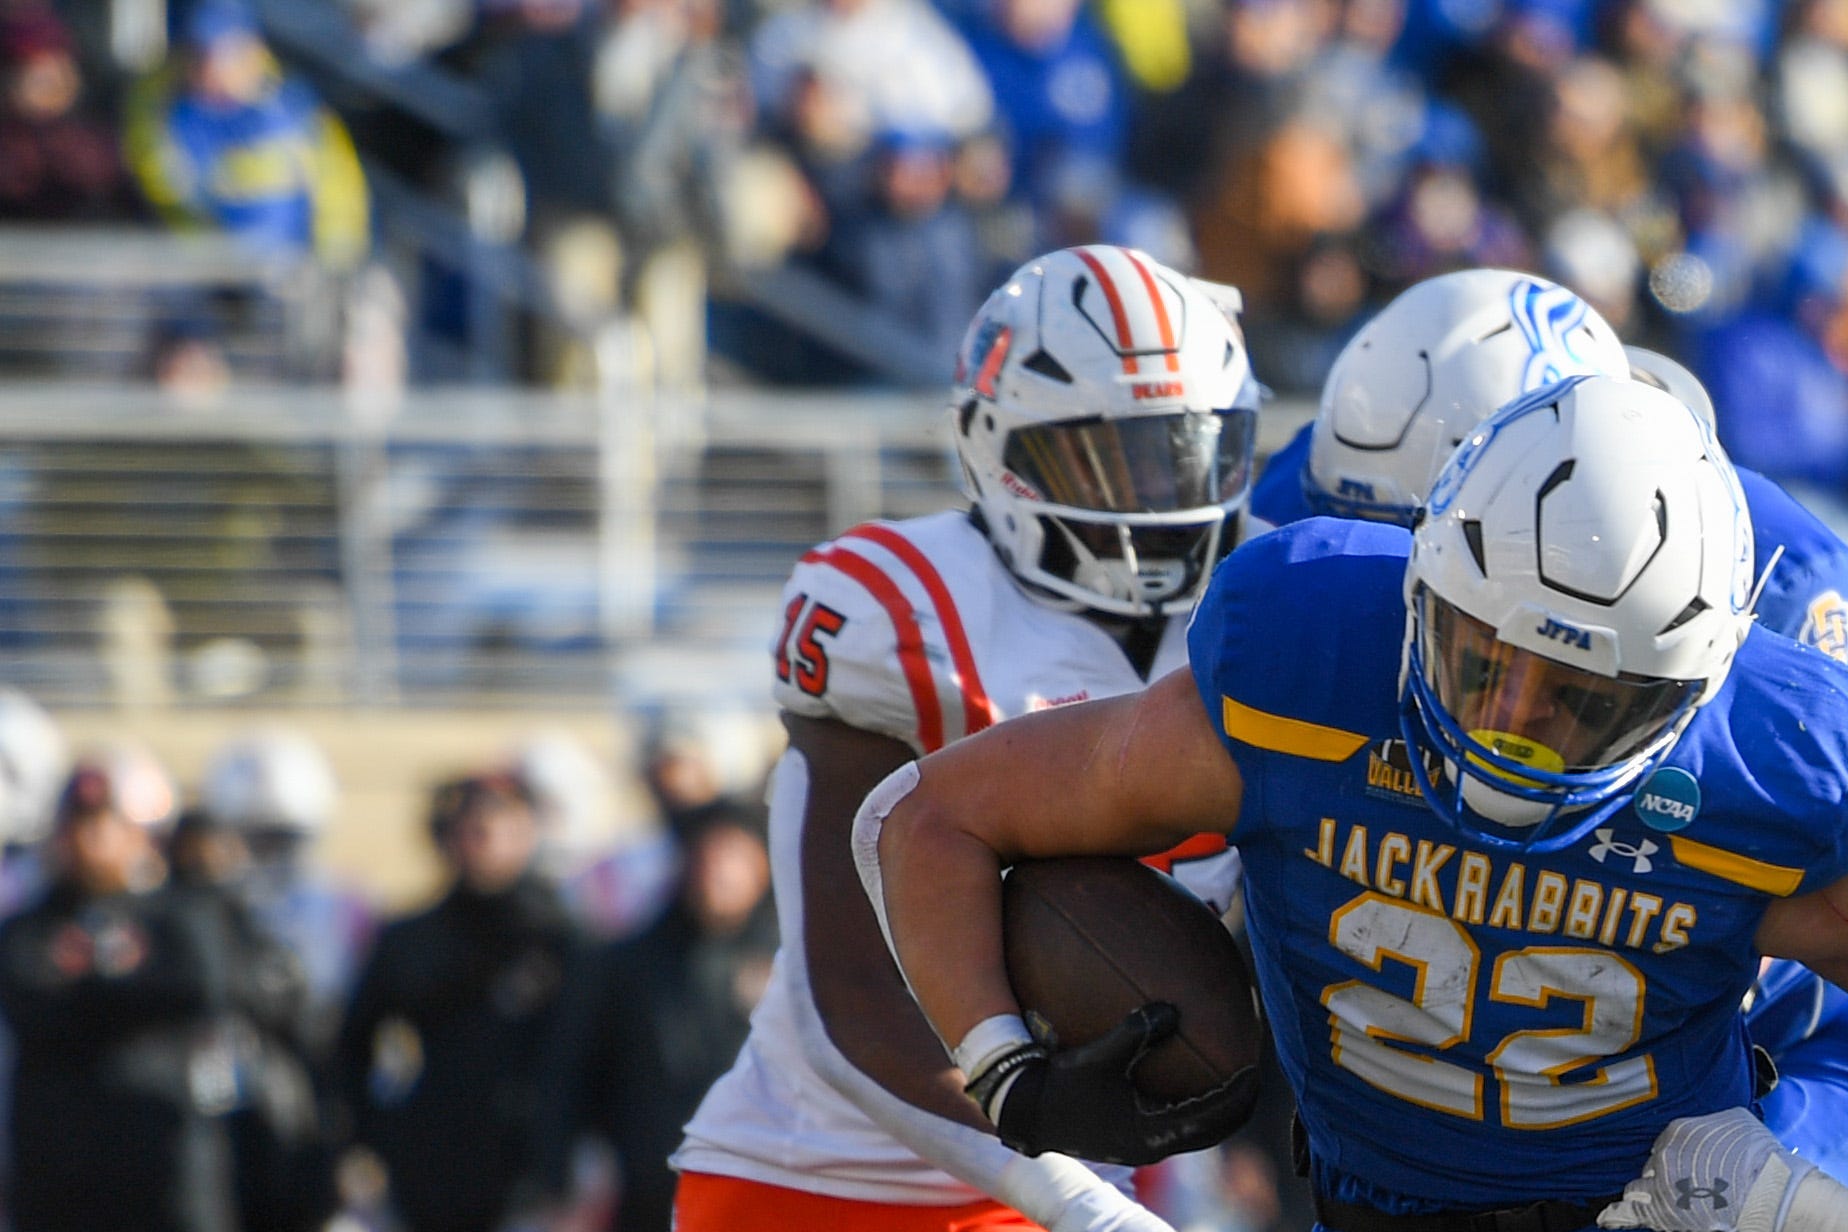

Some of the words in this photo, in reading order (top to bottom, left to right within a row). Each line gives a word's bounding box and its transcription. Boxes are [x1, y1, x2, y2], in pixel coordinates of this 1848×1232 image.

[775, 591, 848, 699] 15
[1536, 617, 1592, 652] JFPA
[1639, 792, 1695, 822] NCAA
[1304, 817, 1697, 955] JACKRABBITS
[1319, 888, 1659, 1131] 22
